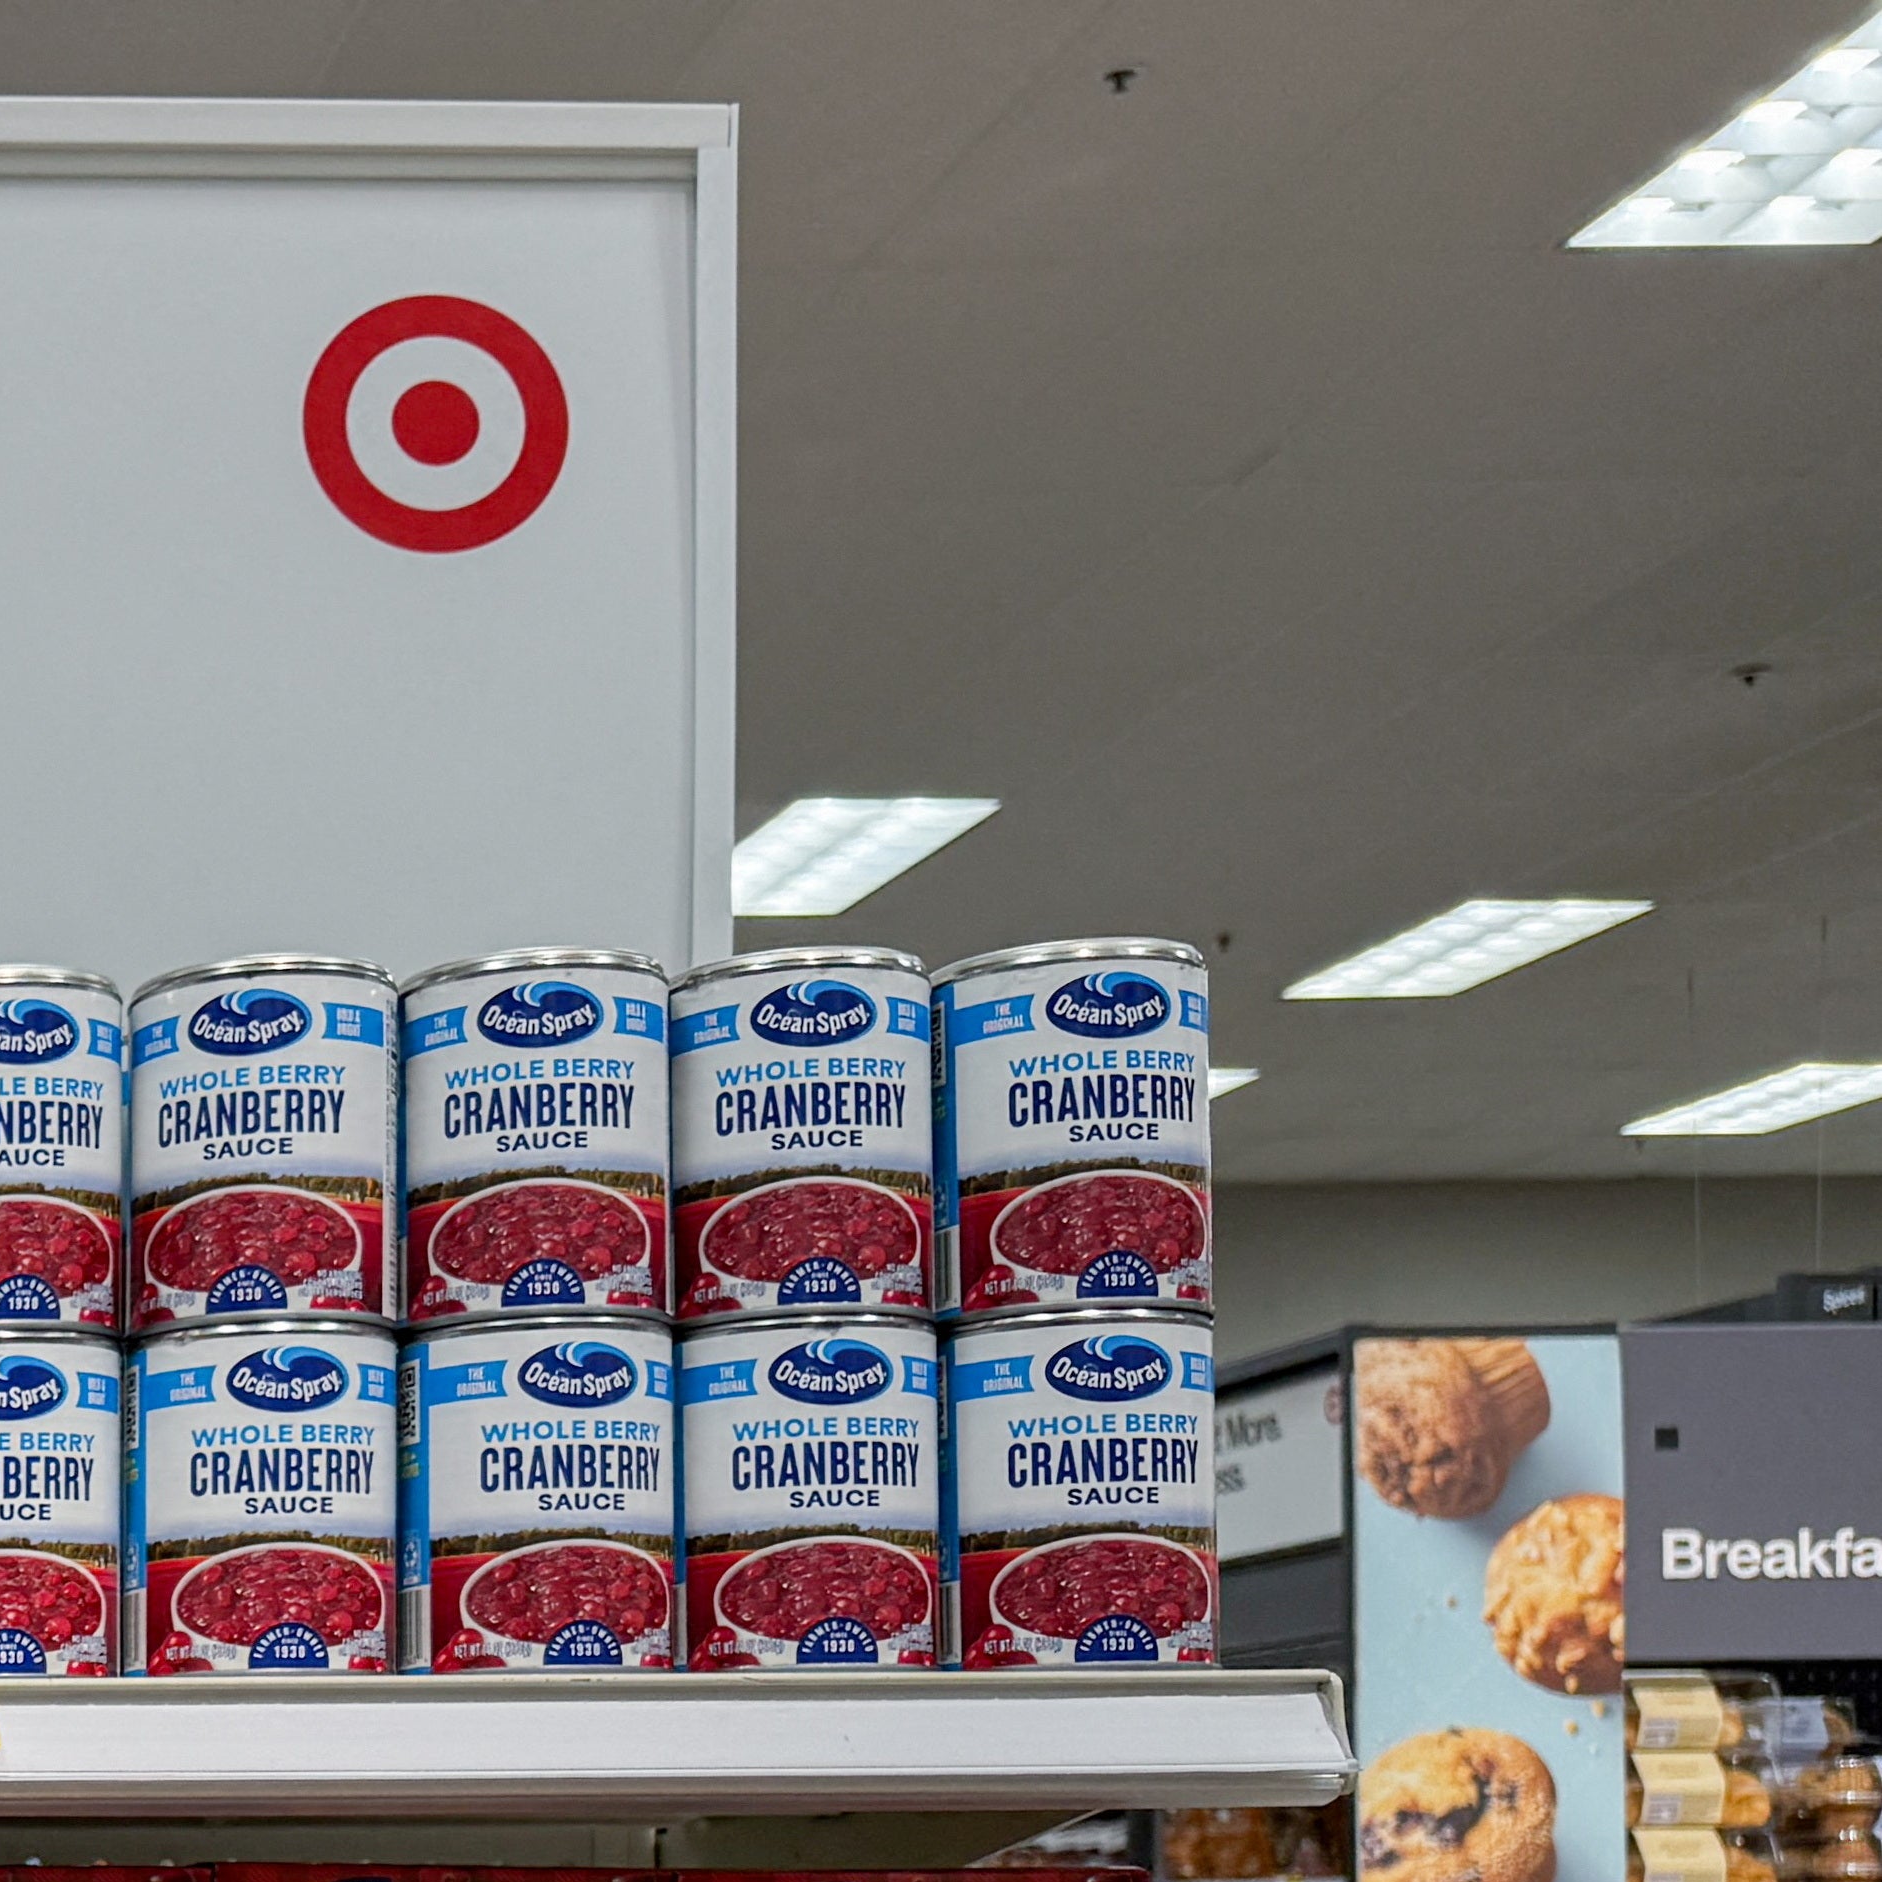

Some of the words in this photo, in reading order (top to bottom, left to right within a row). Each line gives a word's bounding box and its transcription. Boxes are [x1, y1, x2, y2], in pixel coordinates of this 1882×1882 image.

[159, 1074, 254, 1099] WHOLE
[261, 1064, 346, 1089] BERRY
[1008, 1076, 1195, 1129] CRANBERRY
[158, 1085, 345, 1141] CRANBERRY
[203, 1136, 294, 1161] SAUCE
[1008, 1416, 1111, 1438] WHOLE
[1119, 1414, 1198, 1437] BERRY
[1007, 1437, 1199, 1489] CRANBERRY
[1068, 1485, 1158, 1507] SAUCE
[1662, 1526, 1882, 1579] Breakfa
